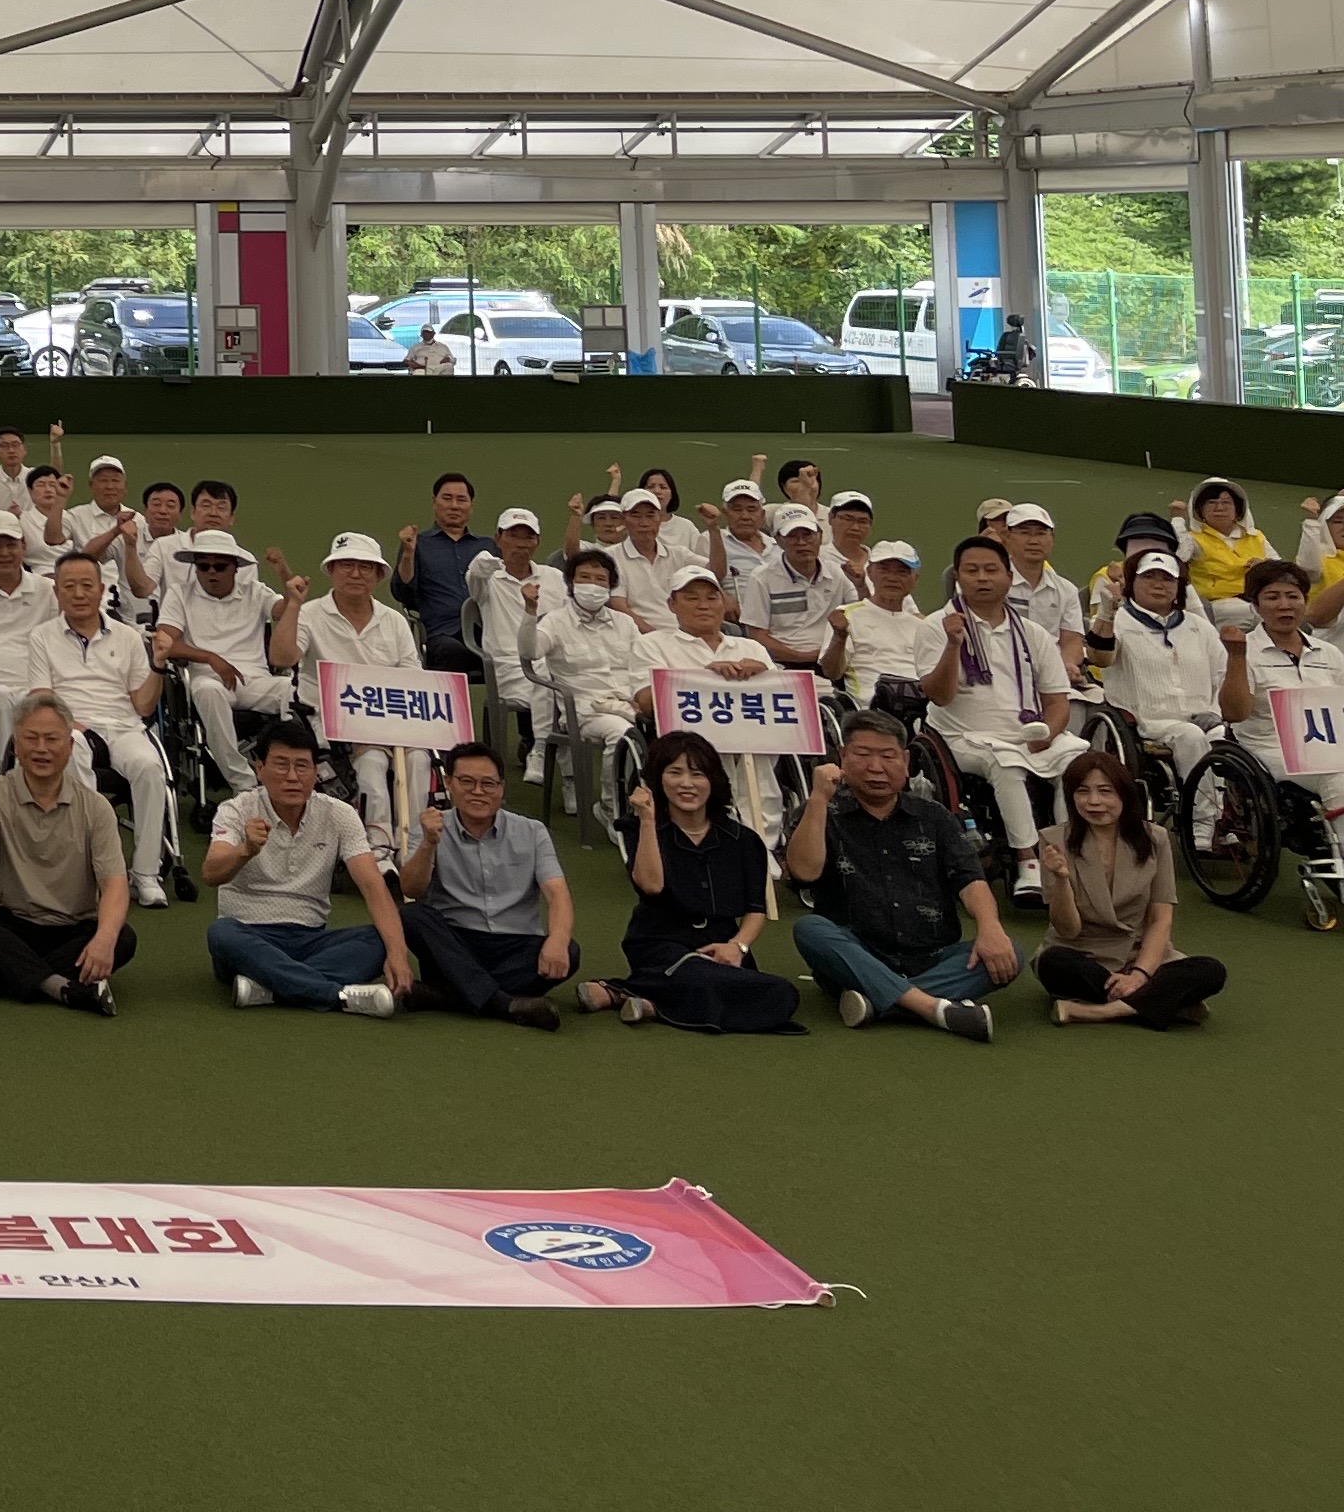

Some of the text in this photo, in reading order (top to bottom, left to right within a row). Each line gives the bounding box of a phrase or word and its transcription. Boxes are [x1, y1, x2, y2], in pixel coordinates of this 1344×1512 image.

[339, 684, 454, 724] 수원특례시
[676, 690, 799, 725] 경상북도
[38, 1273, 141, 1289] 안산시
